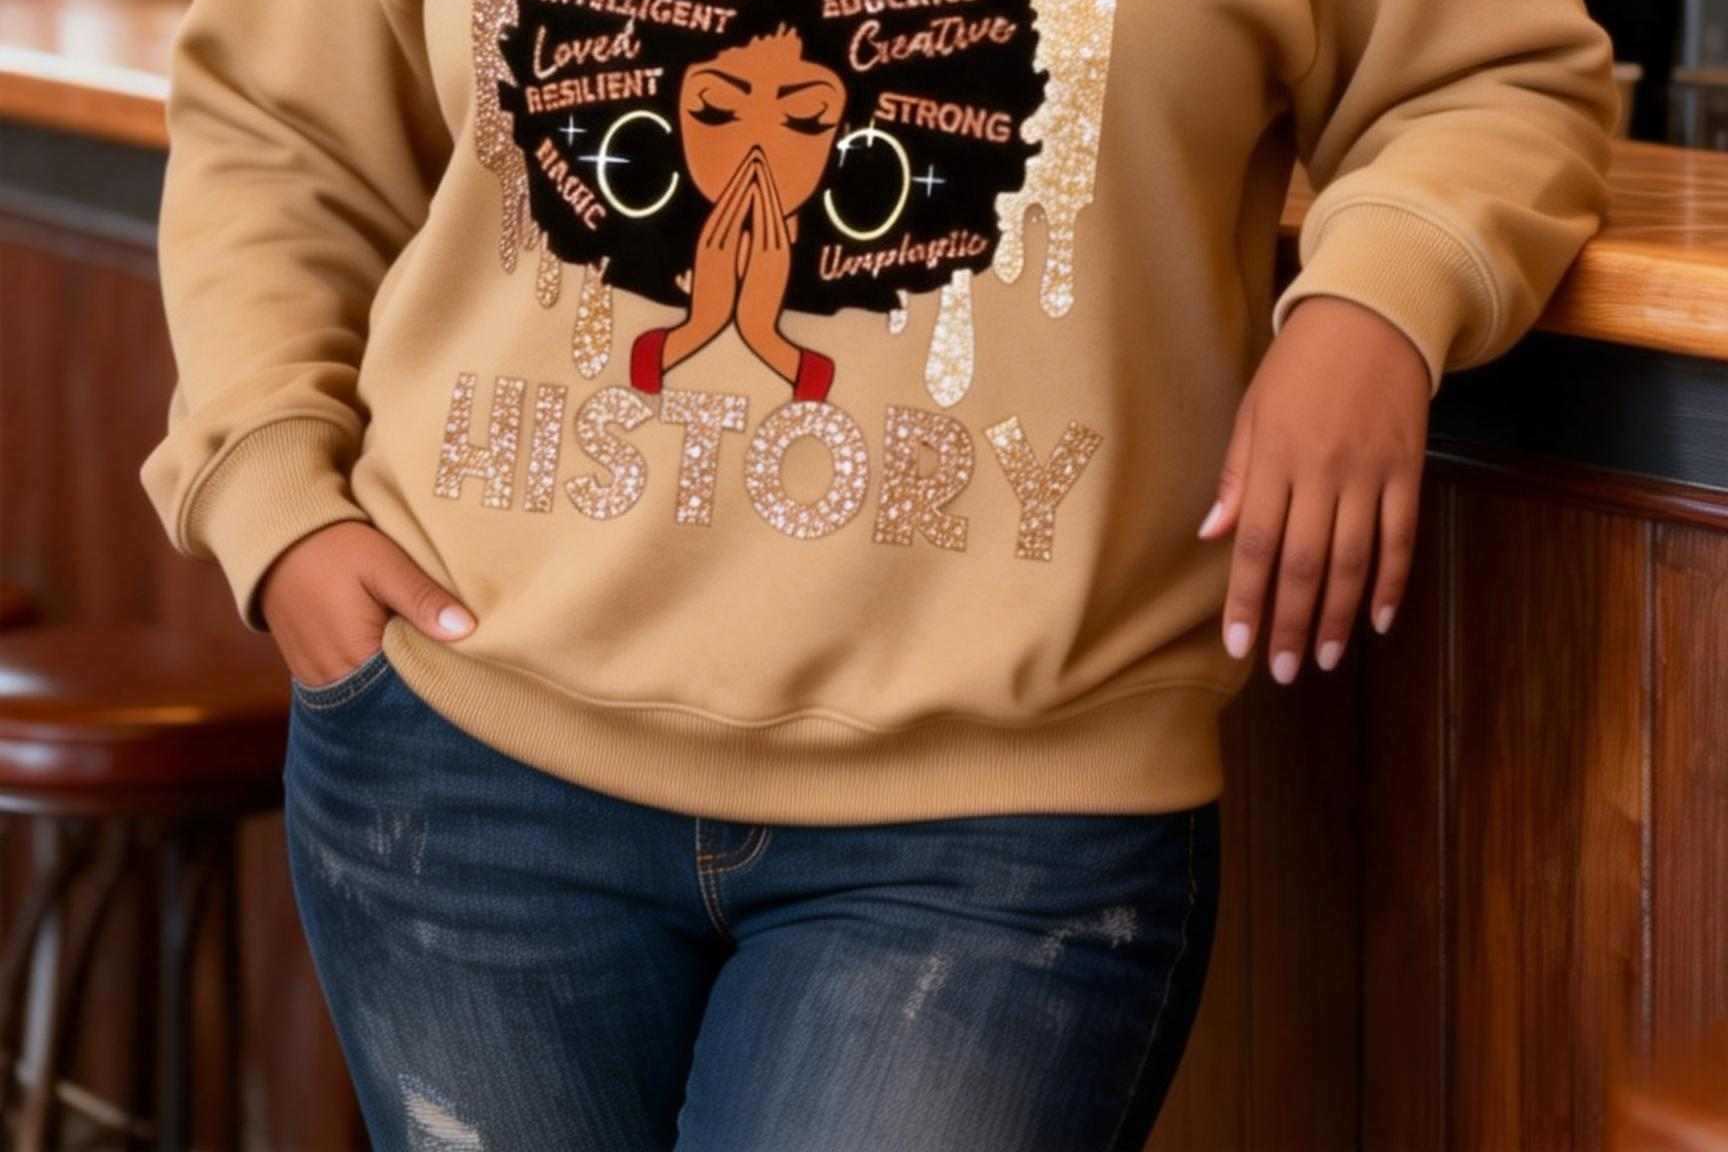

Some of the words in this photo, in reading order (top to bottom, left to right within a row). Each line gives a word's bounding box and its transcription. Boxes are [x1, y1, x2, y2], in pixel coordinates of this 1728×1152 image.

[525, 67, 664, 115] RESILIENT
[873, 92, 1012, 143] STRONG
[432, 371, 1103, 562] HISTORY
